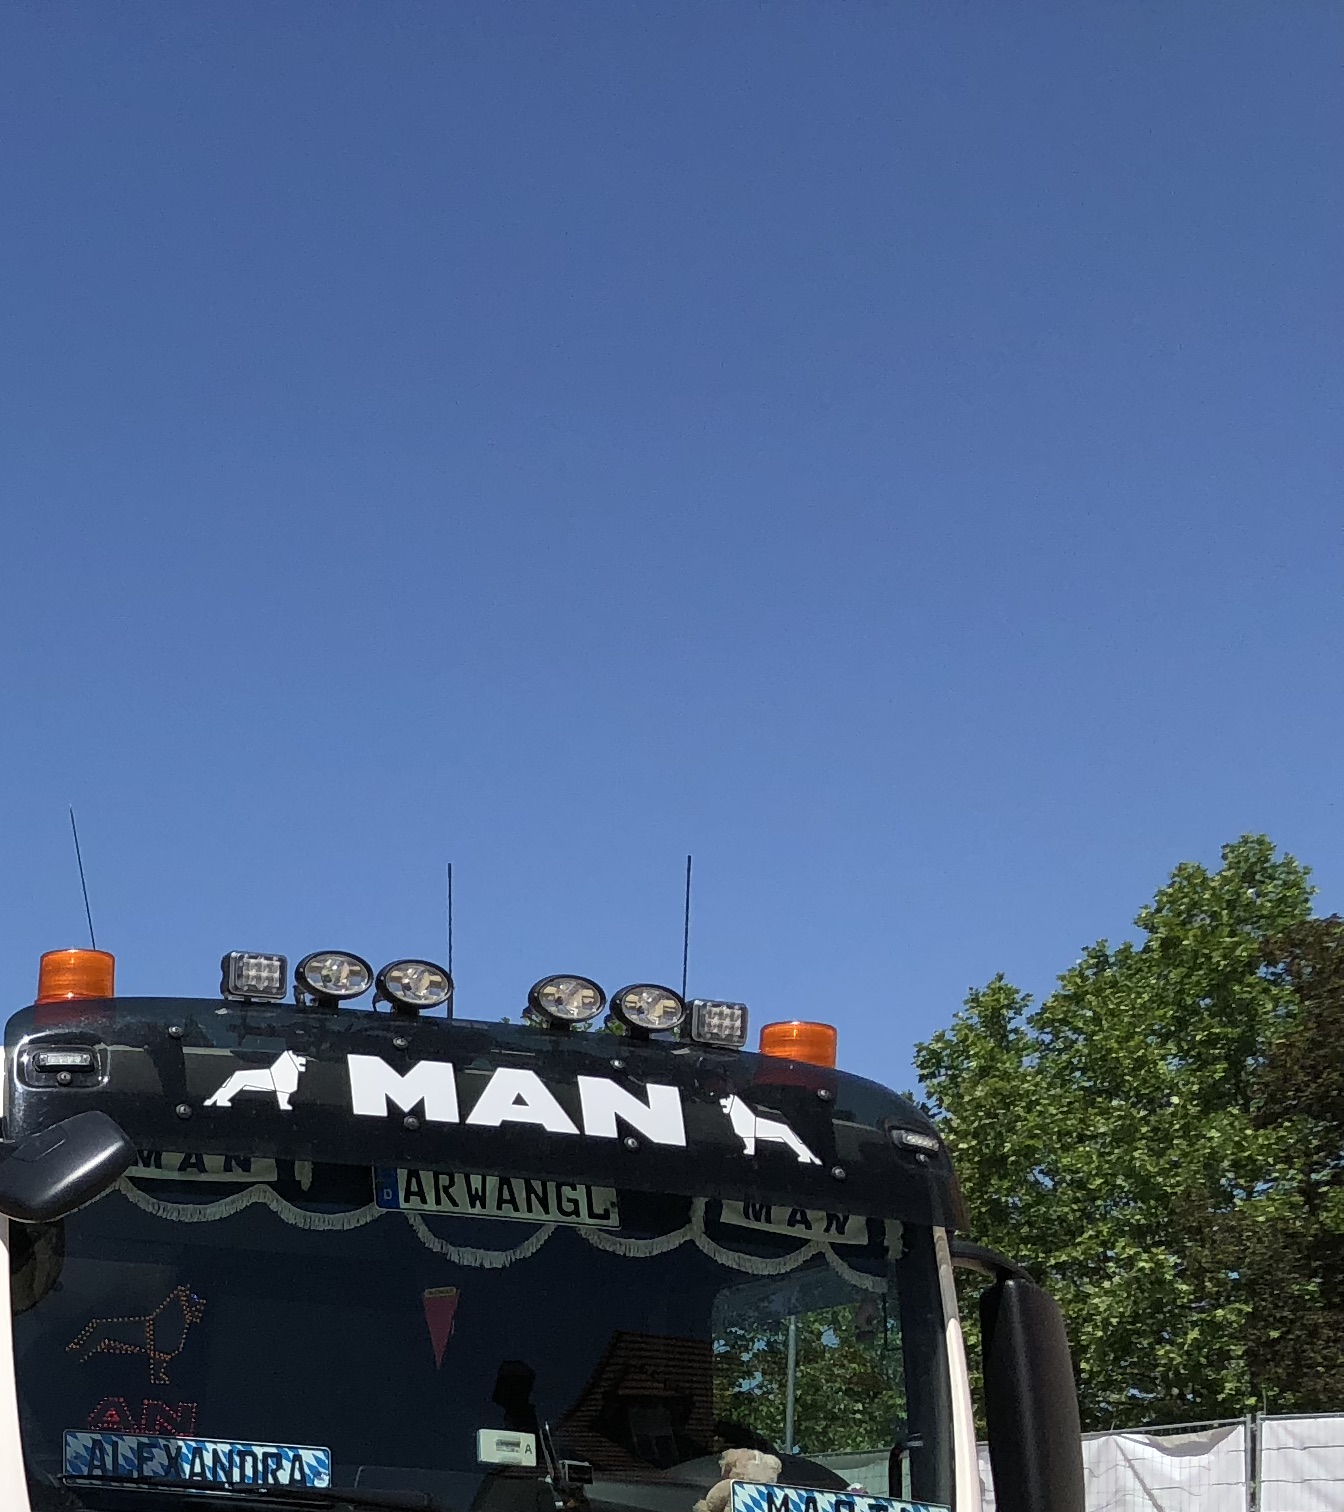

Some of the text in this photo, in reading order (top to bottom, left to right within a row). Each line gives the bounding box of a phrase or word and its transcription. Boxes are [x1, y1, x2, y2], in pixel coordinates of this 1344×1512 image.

[347, 1053, 687, 1147] MAN
[135, 1150, 252, 1174] MAN
[383, 1188, 393, 1200] D
[403, 1168, 612, 1221] ARWANGL
[742, 1200, 850, 1236] MAN
[86, 1437, 307, 1486] ALEXANDRA
[524, 1443, 533, 1455] A
